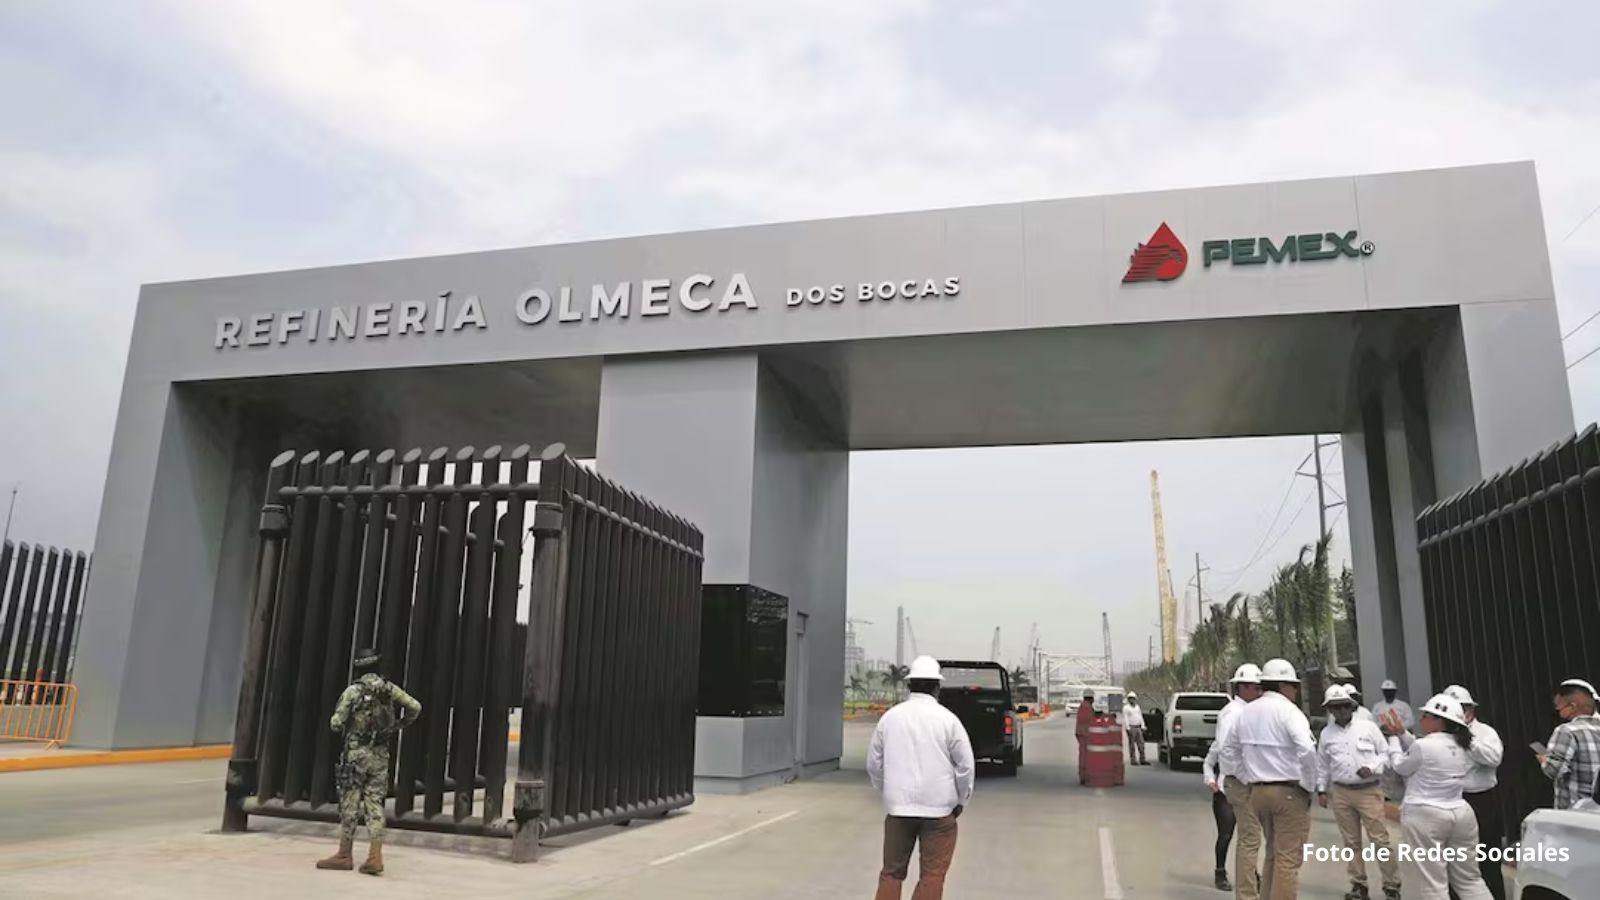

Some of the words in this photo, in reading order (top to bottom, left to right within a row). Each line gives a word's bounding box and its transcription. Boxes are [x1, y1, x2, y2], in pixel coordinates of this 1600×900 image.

[214, 290, 487, 350] REFINERÍA
[515, 272, 759, 325] OLMECA
[786, 284, 846, 307] DOS
[858, 276, 962, 303] BOCAS
